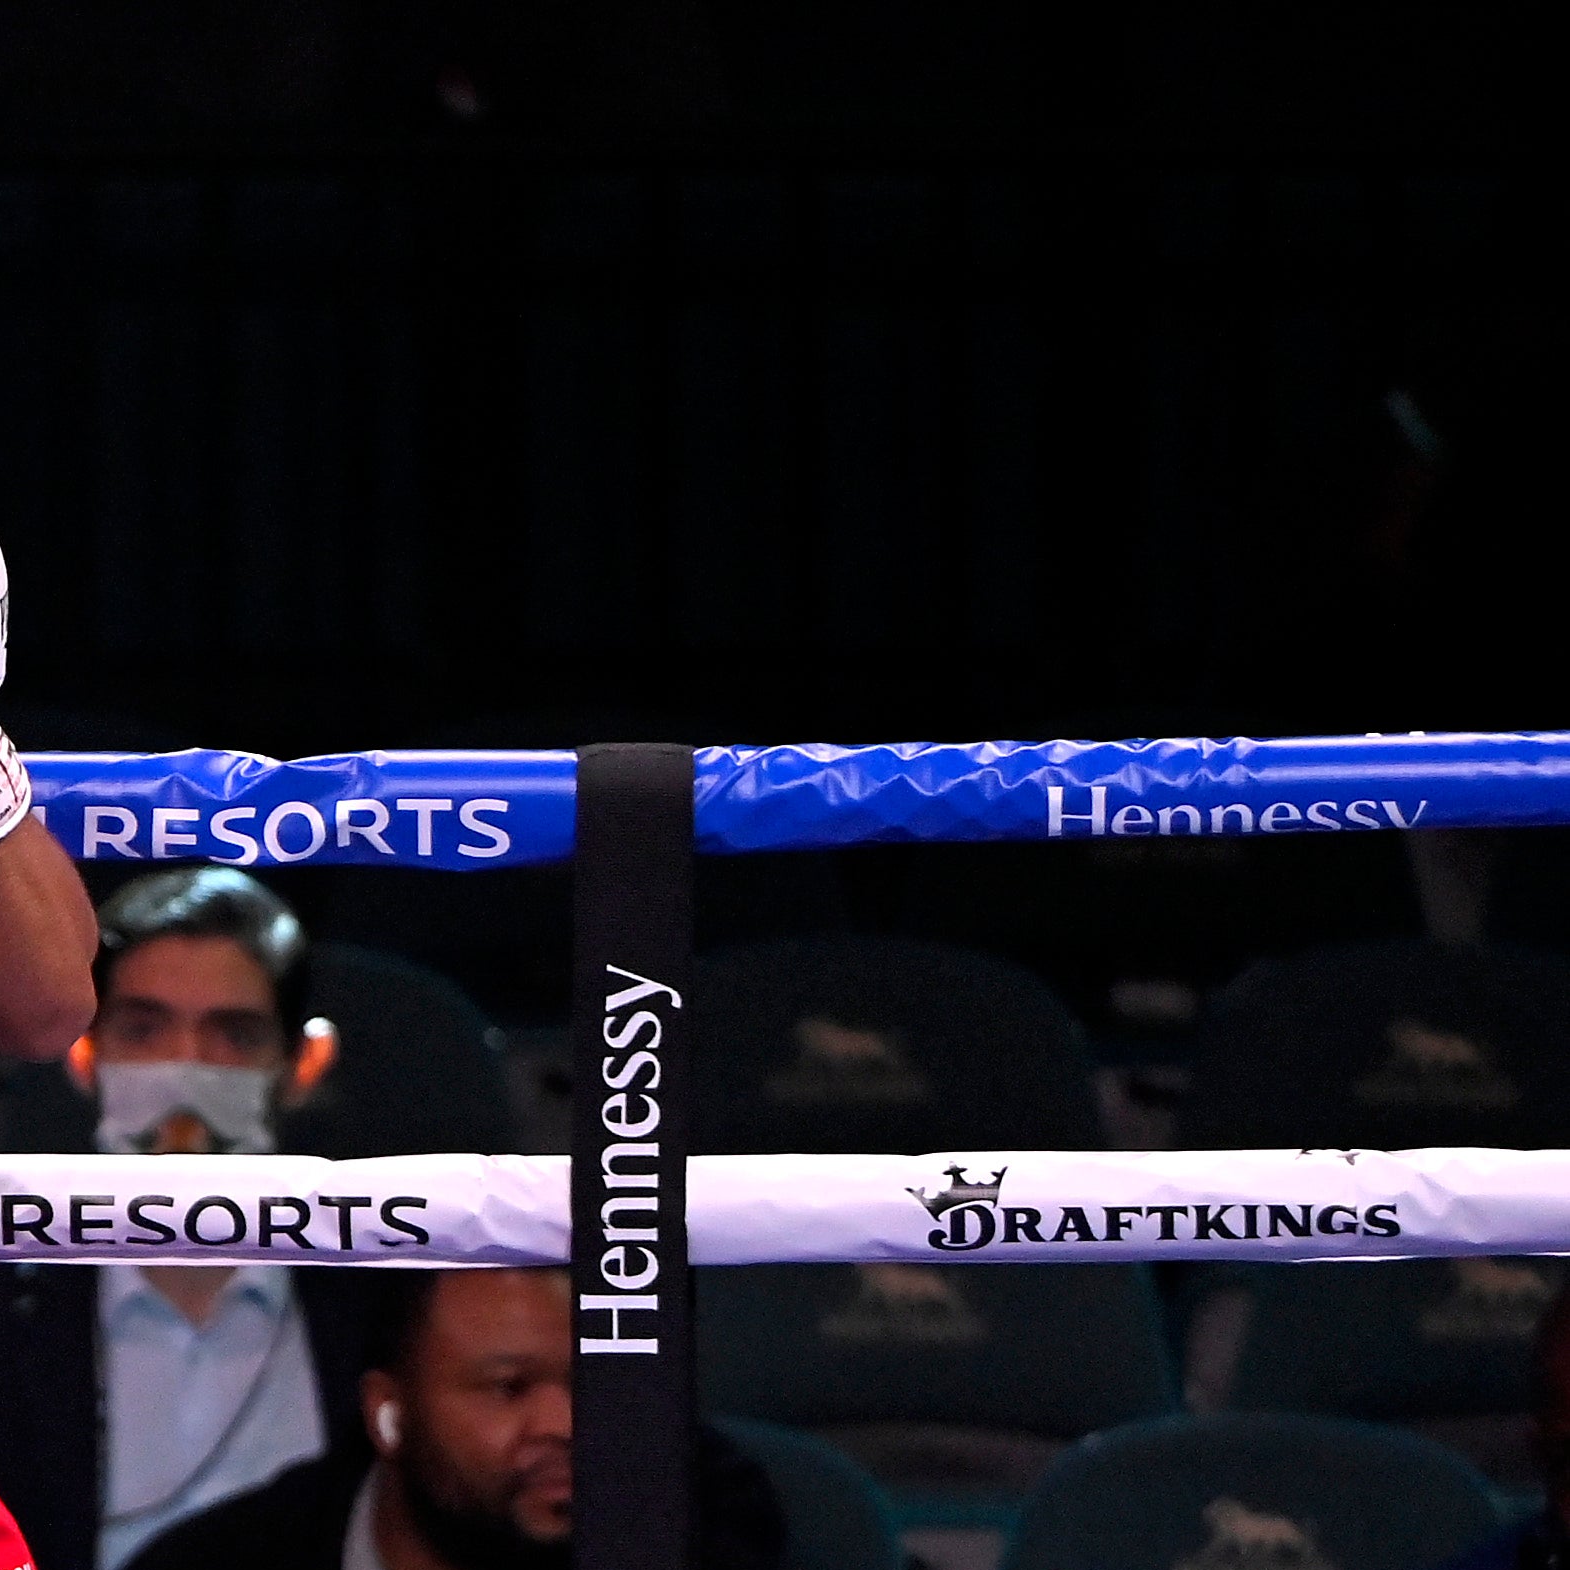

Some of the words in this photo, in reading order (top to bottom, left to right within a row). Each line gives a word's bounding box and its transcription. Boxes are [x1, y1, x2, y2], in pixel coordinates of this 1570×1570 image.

[83, 797, 511, 866] RESORTS
[1048, 785, 1428, 838] Hennessy
[580, 965, 683, 1355] Hennessy
[1, 1195, 430, 1250] RESORTS
[927, 1202, 1402, 1251] DRAFTKINGS
